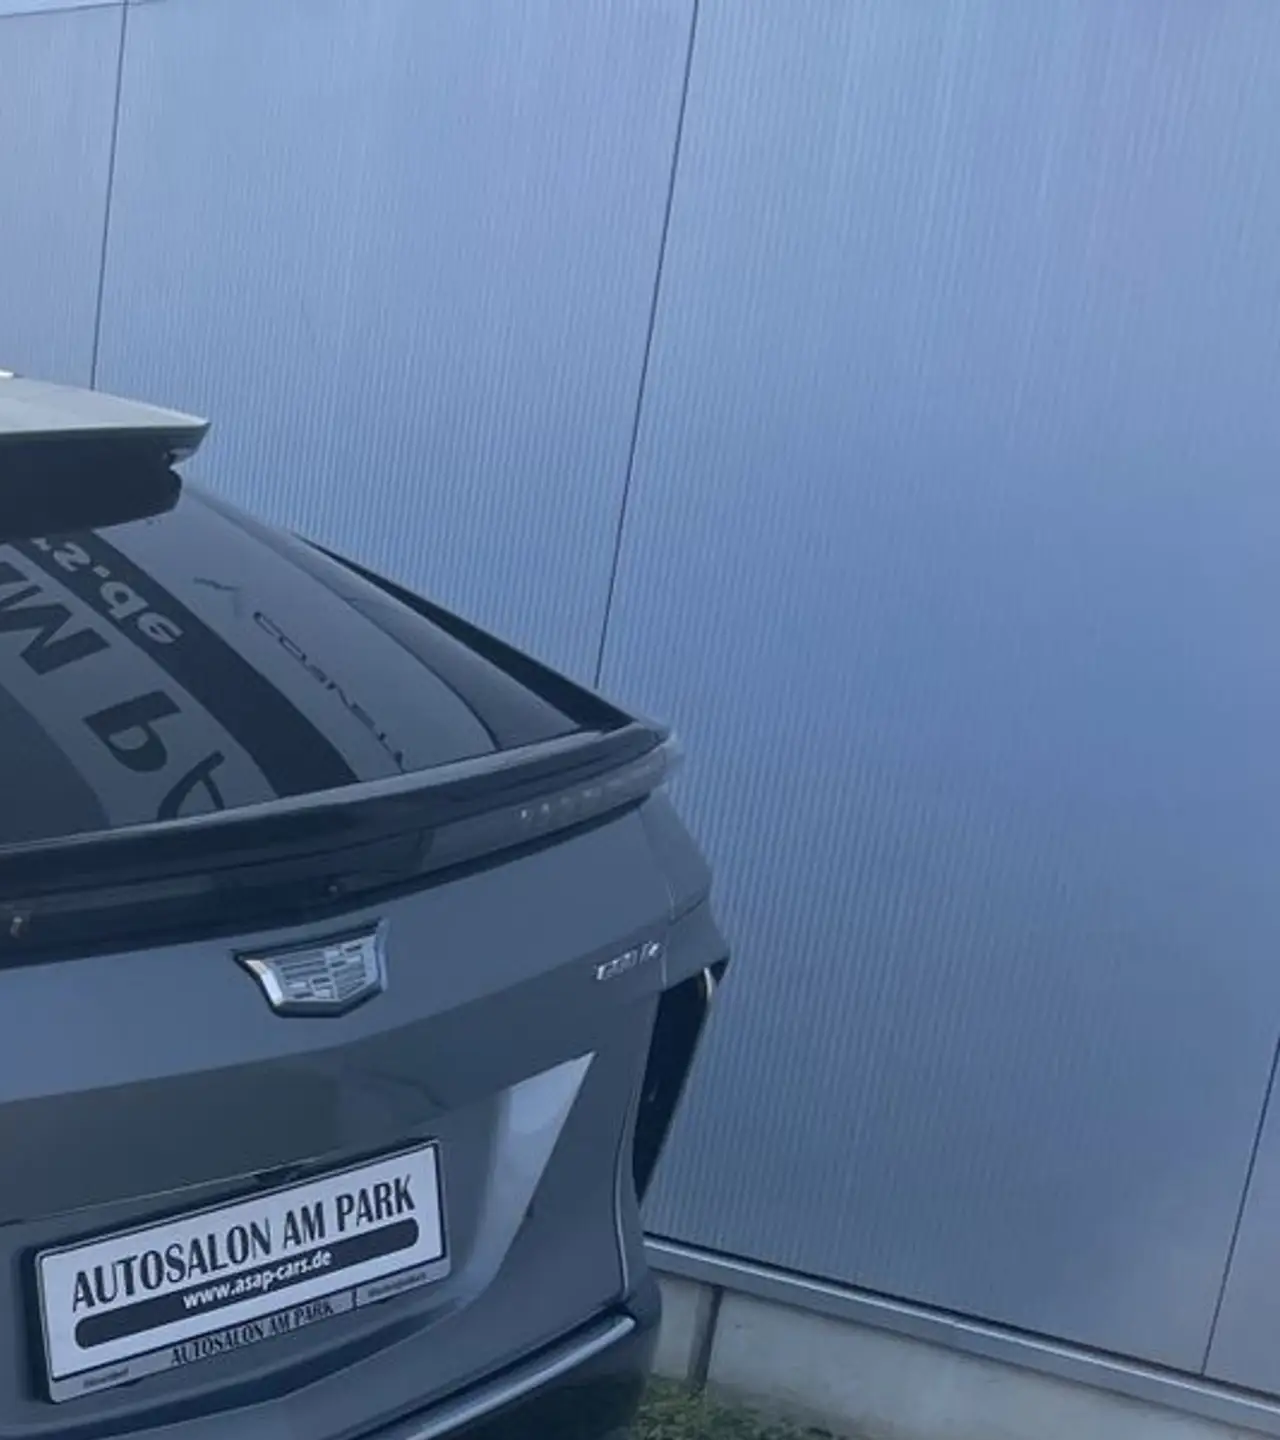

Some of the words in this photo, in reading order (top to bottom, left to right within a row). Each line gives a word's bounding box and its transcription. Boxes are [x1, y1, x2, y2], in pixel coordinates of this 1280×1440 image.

[71, 1216, 271, 1313] AUTOSALON
[282, 1202, 326, 1249] AM
[336, 1174, 416, 1233] PARK
[182, 1249, 333, 1310] www.asap-cars.de
[170, 1325, 265, 1367] AUTOSALON
[265, 1316, 292, 1338] AM
[293, 1302, 335, 1328] PARK
